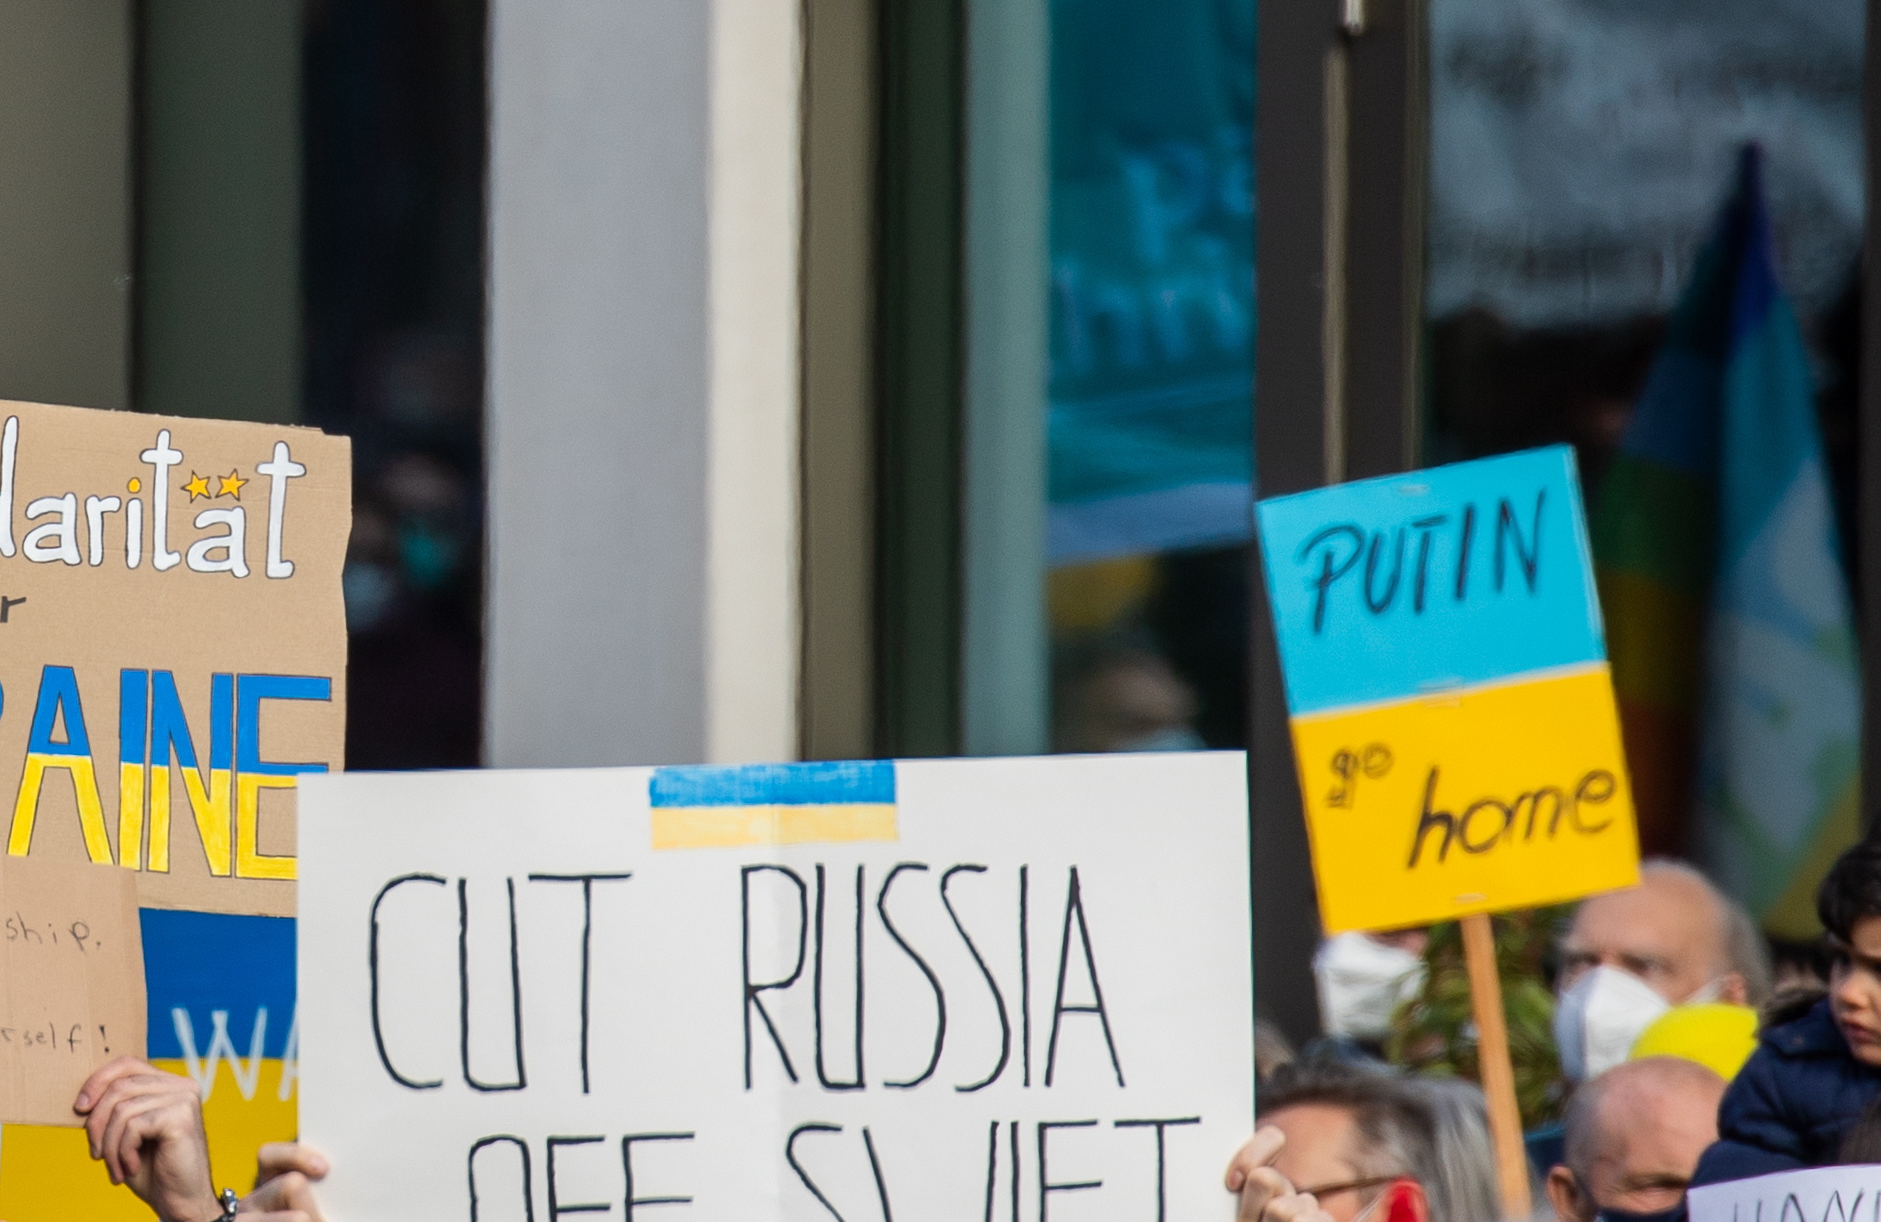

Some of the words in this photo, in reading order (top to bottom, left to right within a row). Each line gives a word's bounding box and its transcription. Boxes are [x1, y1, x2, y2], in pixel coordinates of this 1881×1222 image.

[1299, 487, 1547, 636] PUTIN
[1406, 765, 1618, 871] home
[369, 871, 633, 1093] CUT
[740, 862, 1126, 1092] RUSSIA
